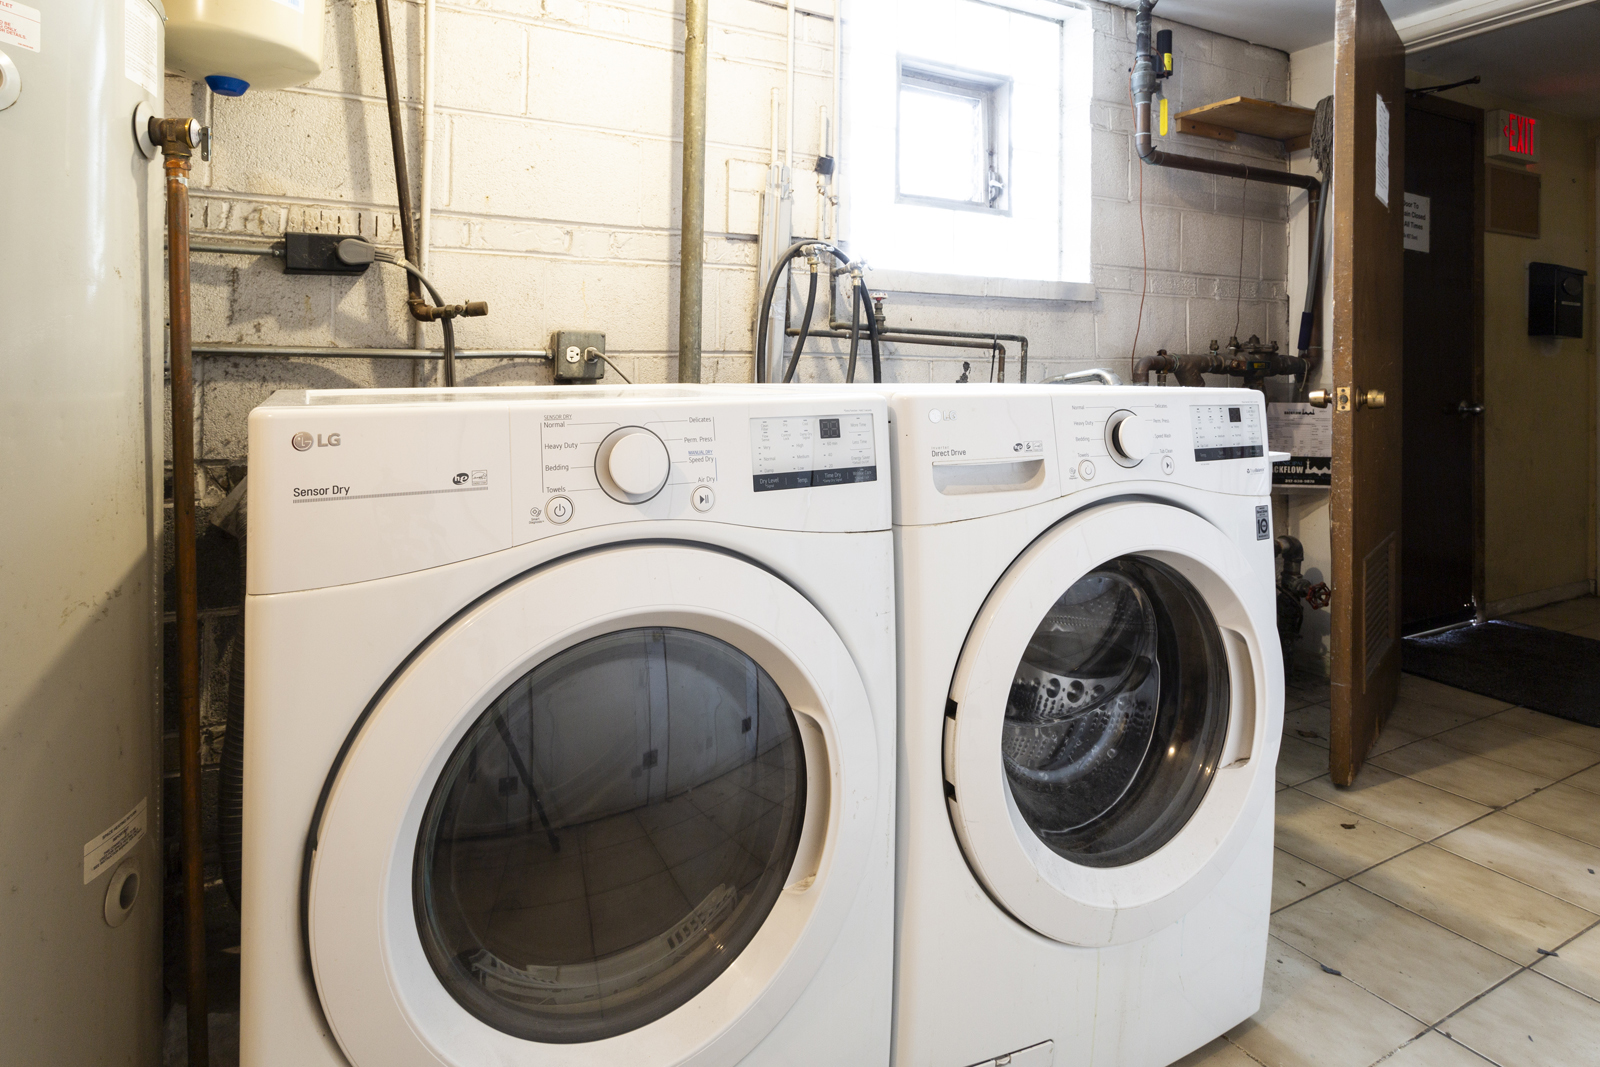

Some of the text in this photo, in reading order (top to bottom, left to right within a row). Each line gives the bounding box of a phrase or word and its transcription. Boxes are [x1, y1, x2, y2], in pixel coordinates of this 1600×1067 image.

[1509, 113, 1535, 155] EXIT
[1412, 212, 1426, 220] Closed
[1411, 222, 1423, 230] Times
[943, 410, 957, 421] LG
[317, 433, 341, 447] LG
[545, 464, 569, 472] Bedding
[1274, 466, 1304, 474] CKFLOW
[293, 485, 350, 497] Sensor Dry
[1258, 518, 1268, 534] 10
